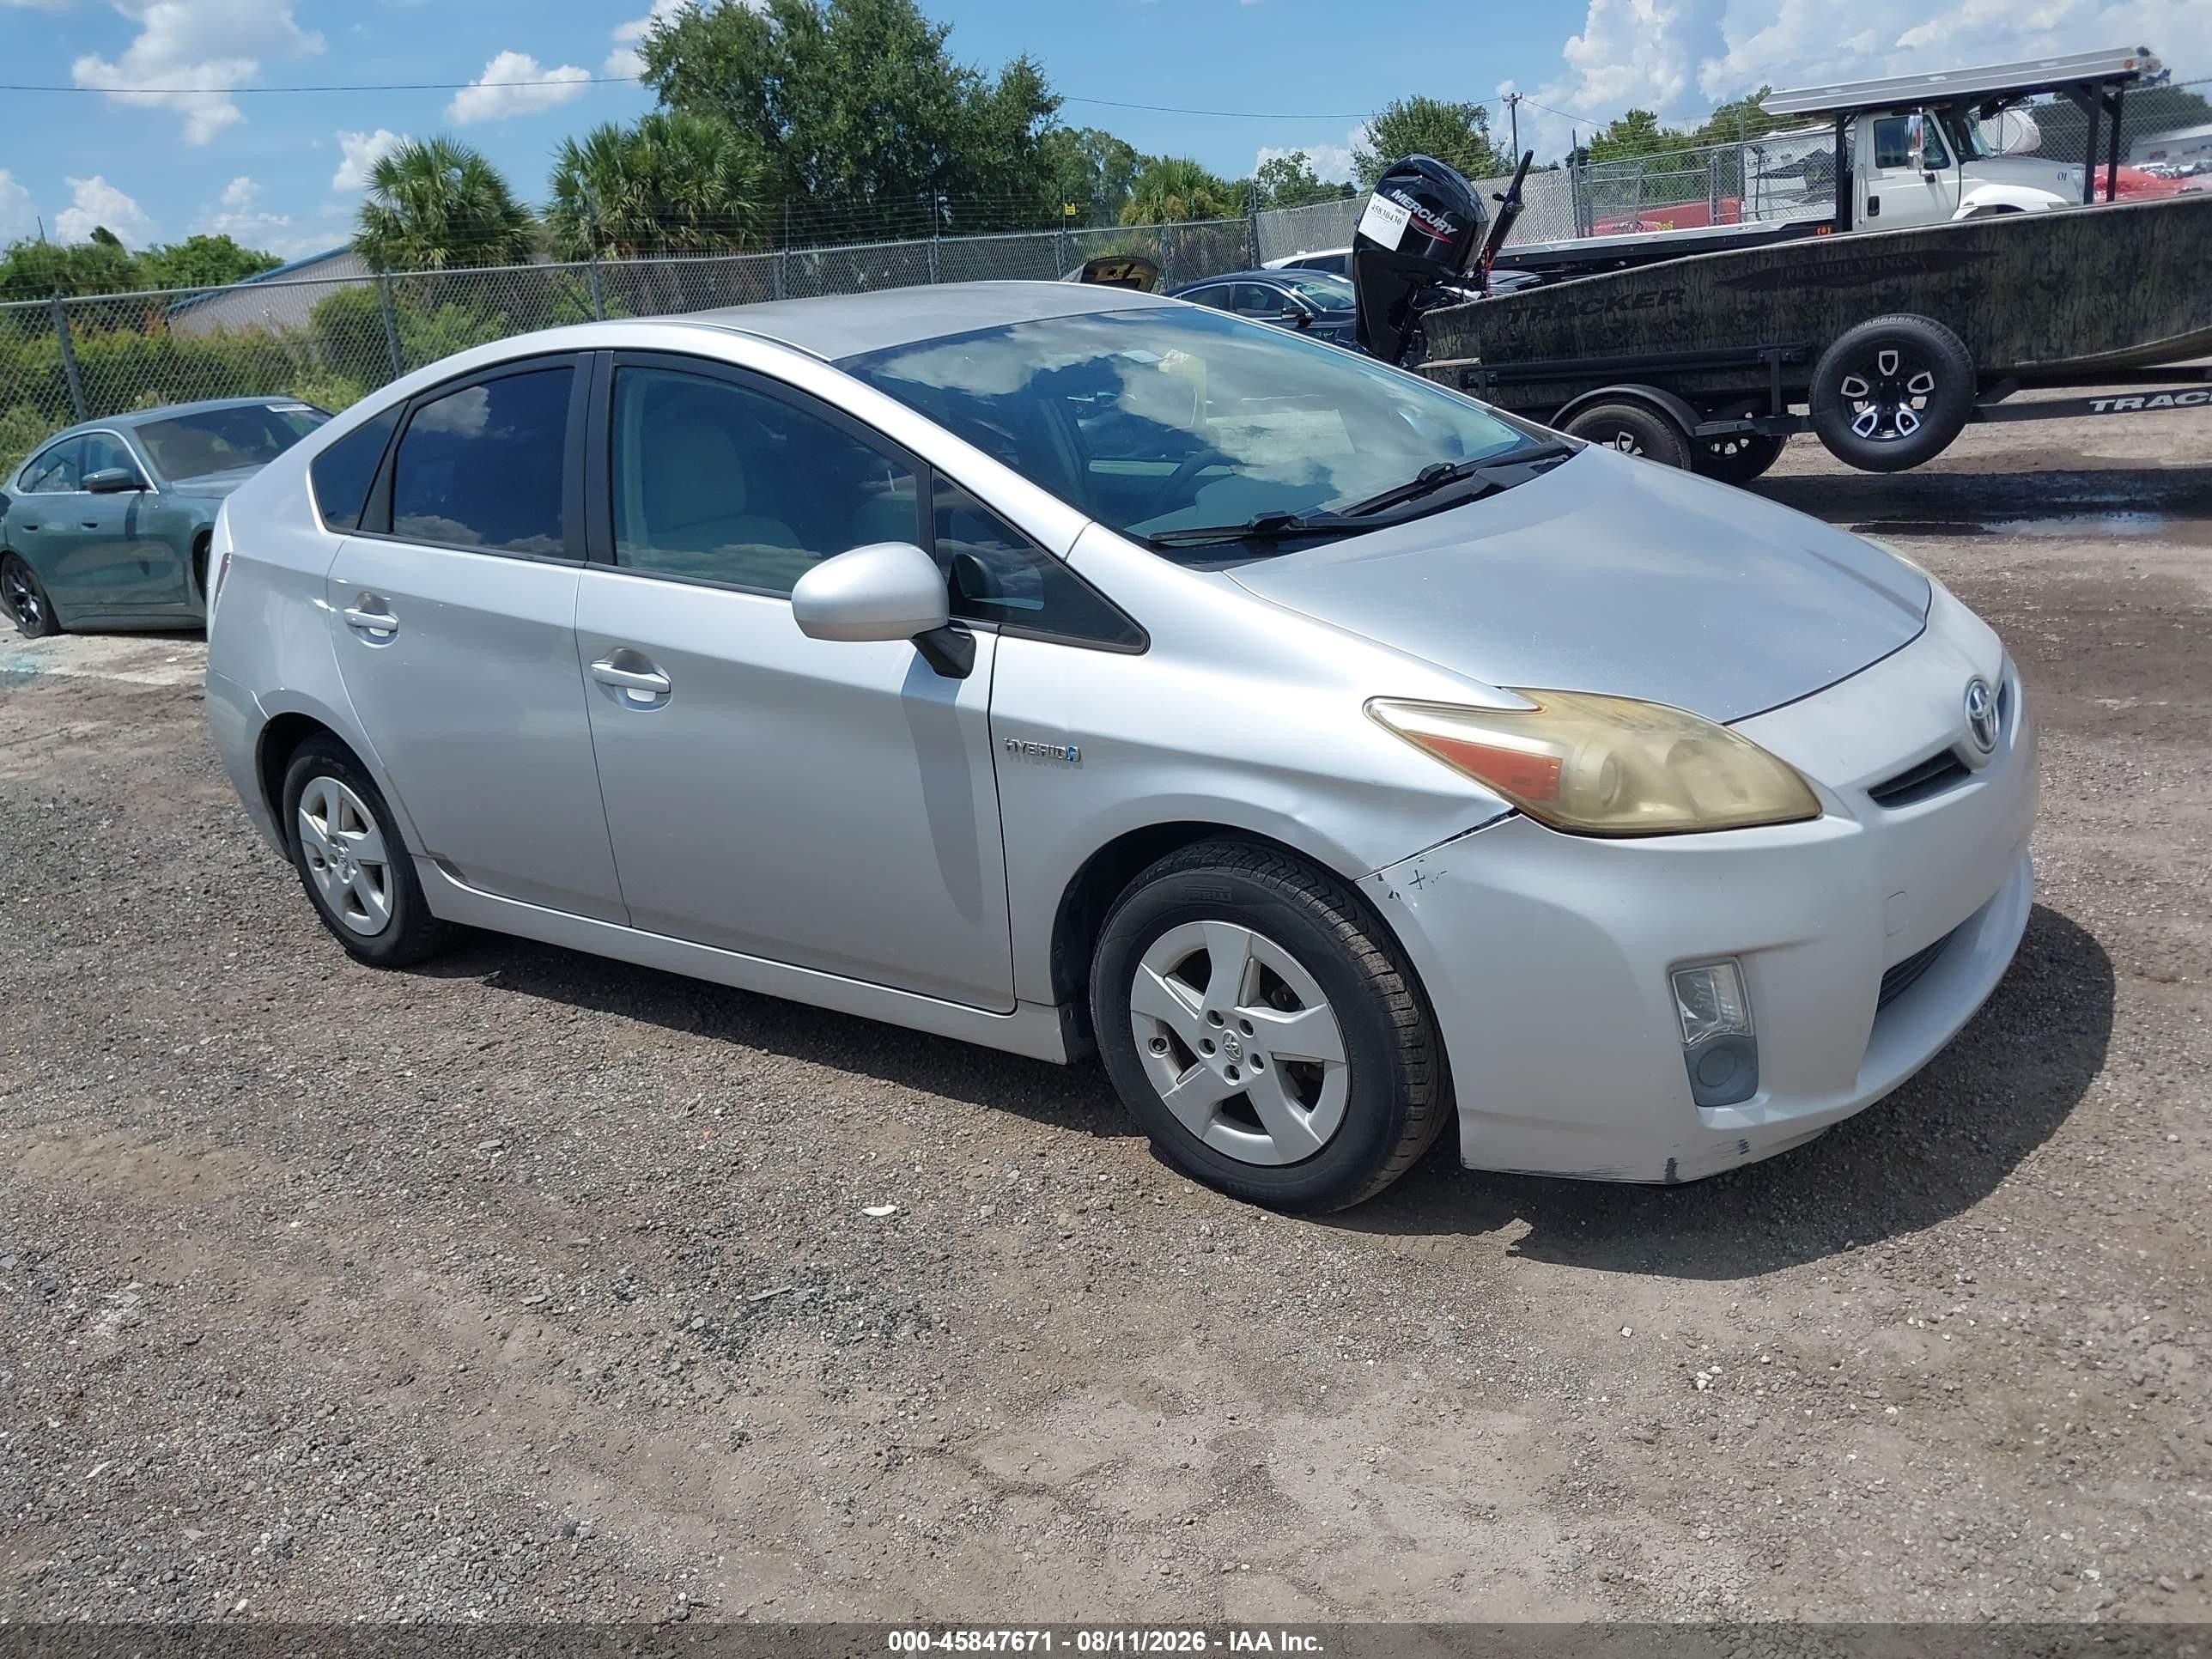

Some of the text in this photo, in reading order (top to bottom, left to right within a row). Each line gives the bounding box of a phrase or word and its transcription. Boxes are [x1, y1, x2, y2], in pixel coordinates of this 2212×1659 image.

[1370, 204, 1402, 226] 45830430
[1390, 189, 1459, 235] MERCURY
[1786, 261, 1854, 279] PRAIRIE
[1858, 254, 1918, 270] WINGS
[1508, 289, 1686, 324] TRACKER
[2088, 391, 2212, 412] TRAC
[1002, 738, 1067, 761] HYBRID
